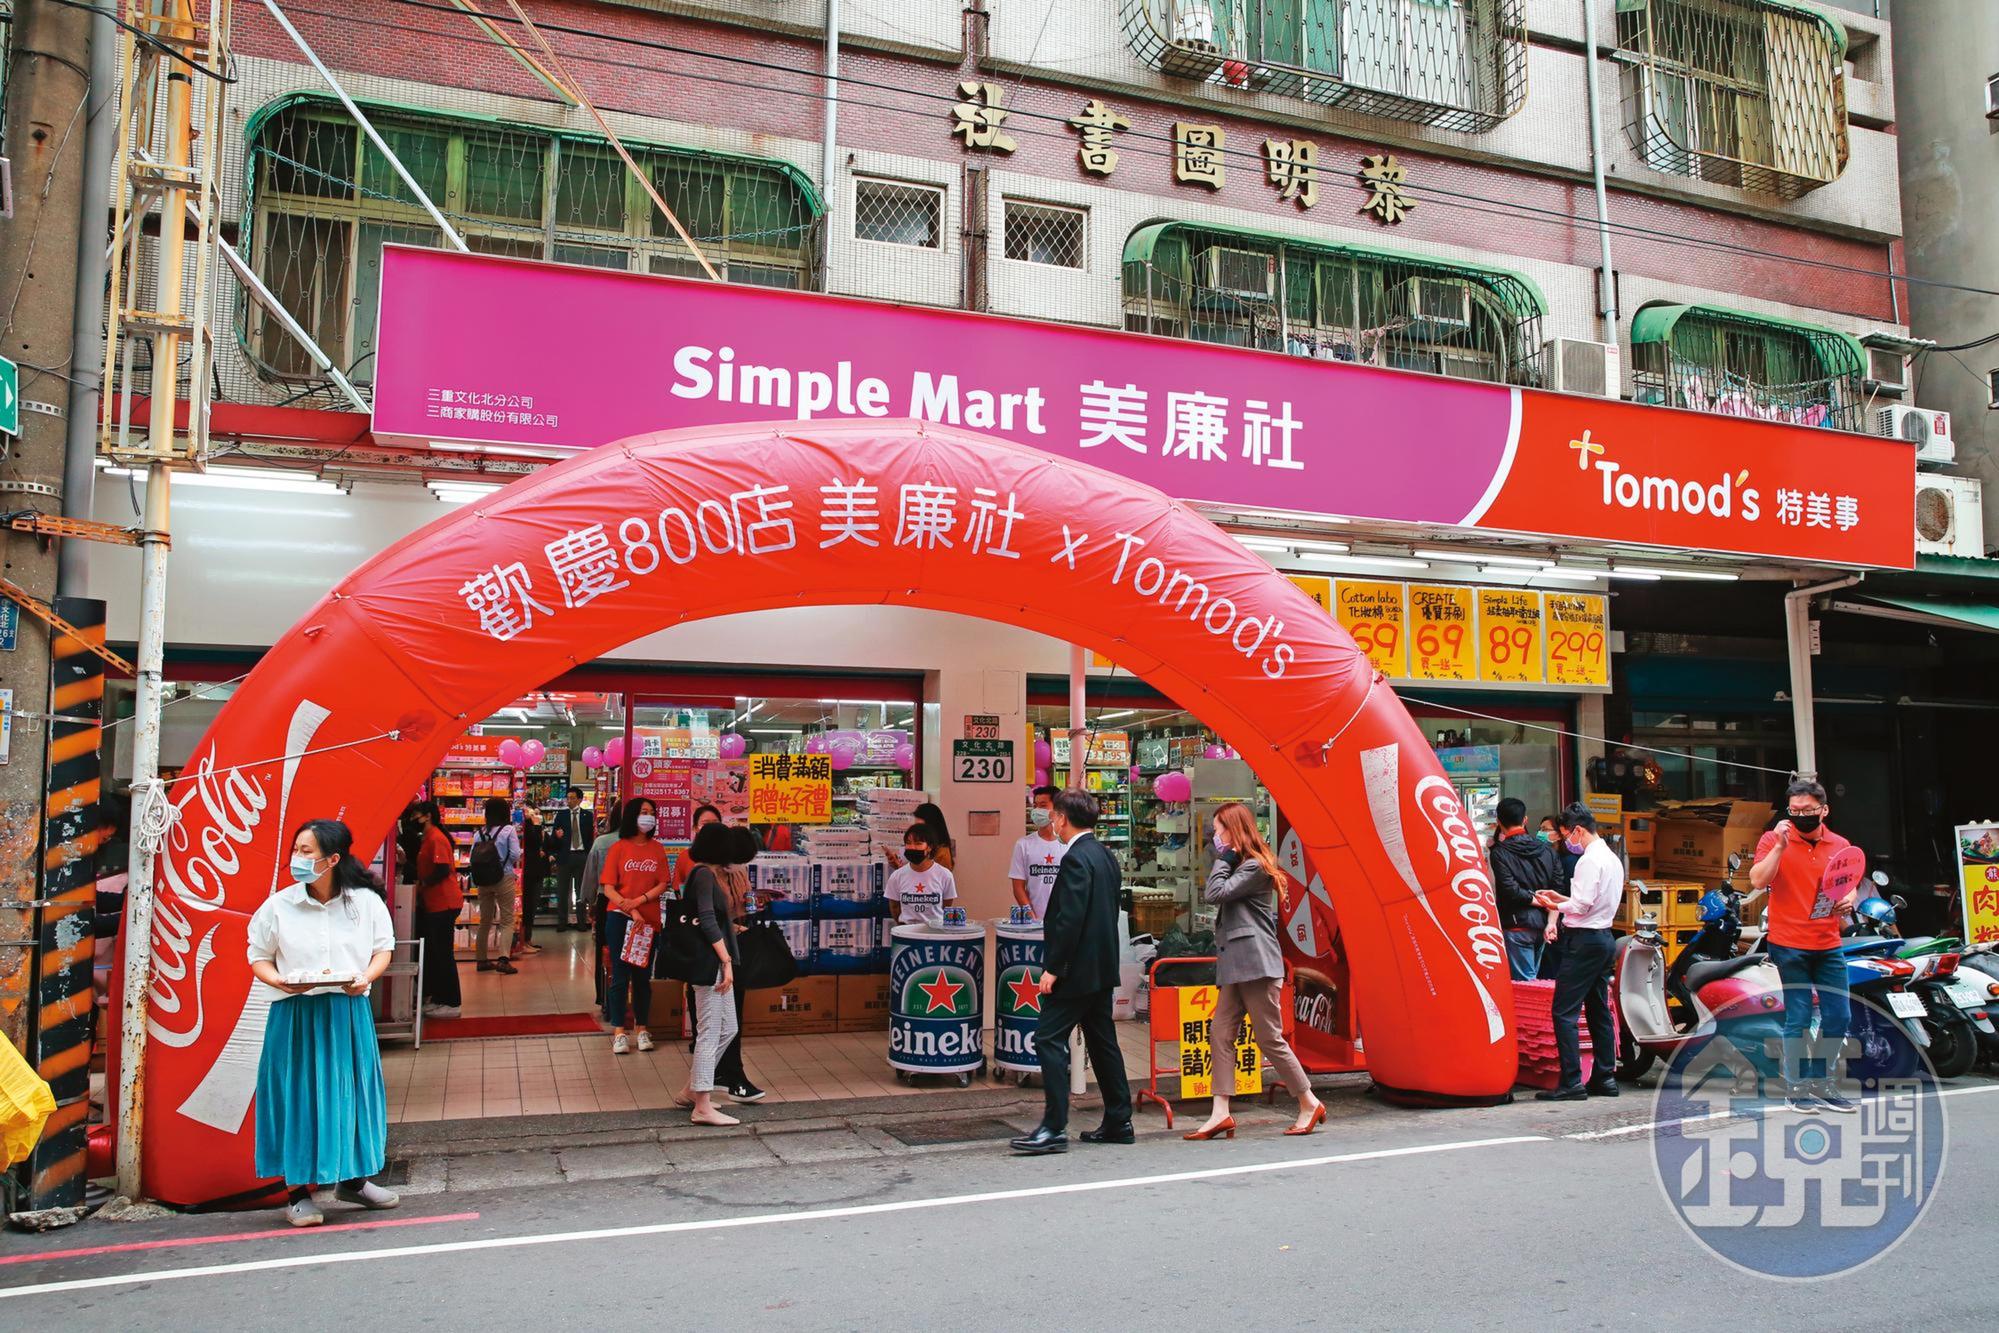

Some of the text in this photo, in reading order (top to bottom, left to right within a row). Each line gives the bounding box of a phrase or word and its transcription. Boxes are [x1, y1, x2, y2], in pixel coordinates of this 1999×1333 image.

[426, 404, 559, 428] 三商家購股份有限公司
[427, 387, 534, 410] 三重文化北分公司
[670, 345, 1305, 471] Simple Mart 美廉社
[1594, 459, 1860, 532] Tomod's 特美事
[458, 483, 797, 642] 歡慶800店
[819, 477, 1025, 560] 美廉社
[1112, 532, 1296, 679] Tomod's
[1341, 586, 1375, 605] Cotton
[1412, 591, 1457, 607] CREATE
[1350, 622, 1399, 659] 69
[1416, 624, 1465, 660] 69
[1489, 625, 1533, 665] 89
[1550, 630, 1603, 665] 299
[975, 726, 997, 738] 230
[753, 755, 831, 781] 消費滿額
[961, 758, 1005, 779] 230
[752, 783, 831, 818] 贈好禮
[1031, 866, 1061, 876] Heinek
[1415, 775, 1509, 971] Coca-Cola
[902, 894, 940, 903] Heineken
[891, 944, 979, 995] HEINEKEN
